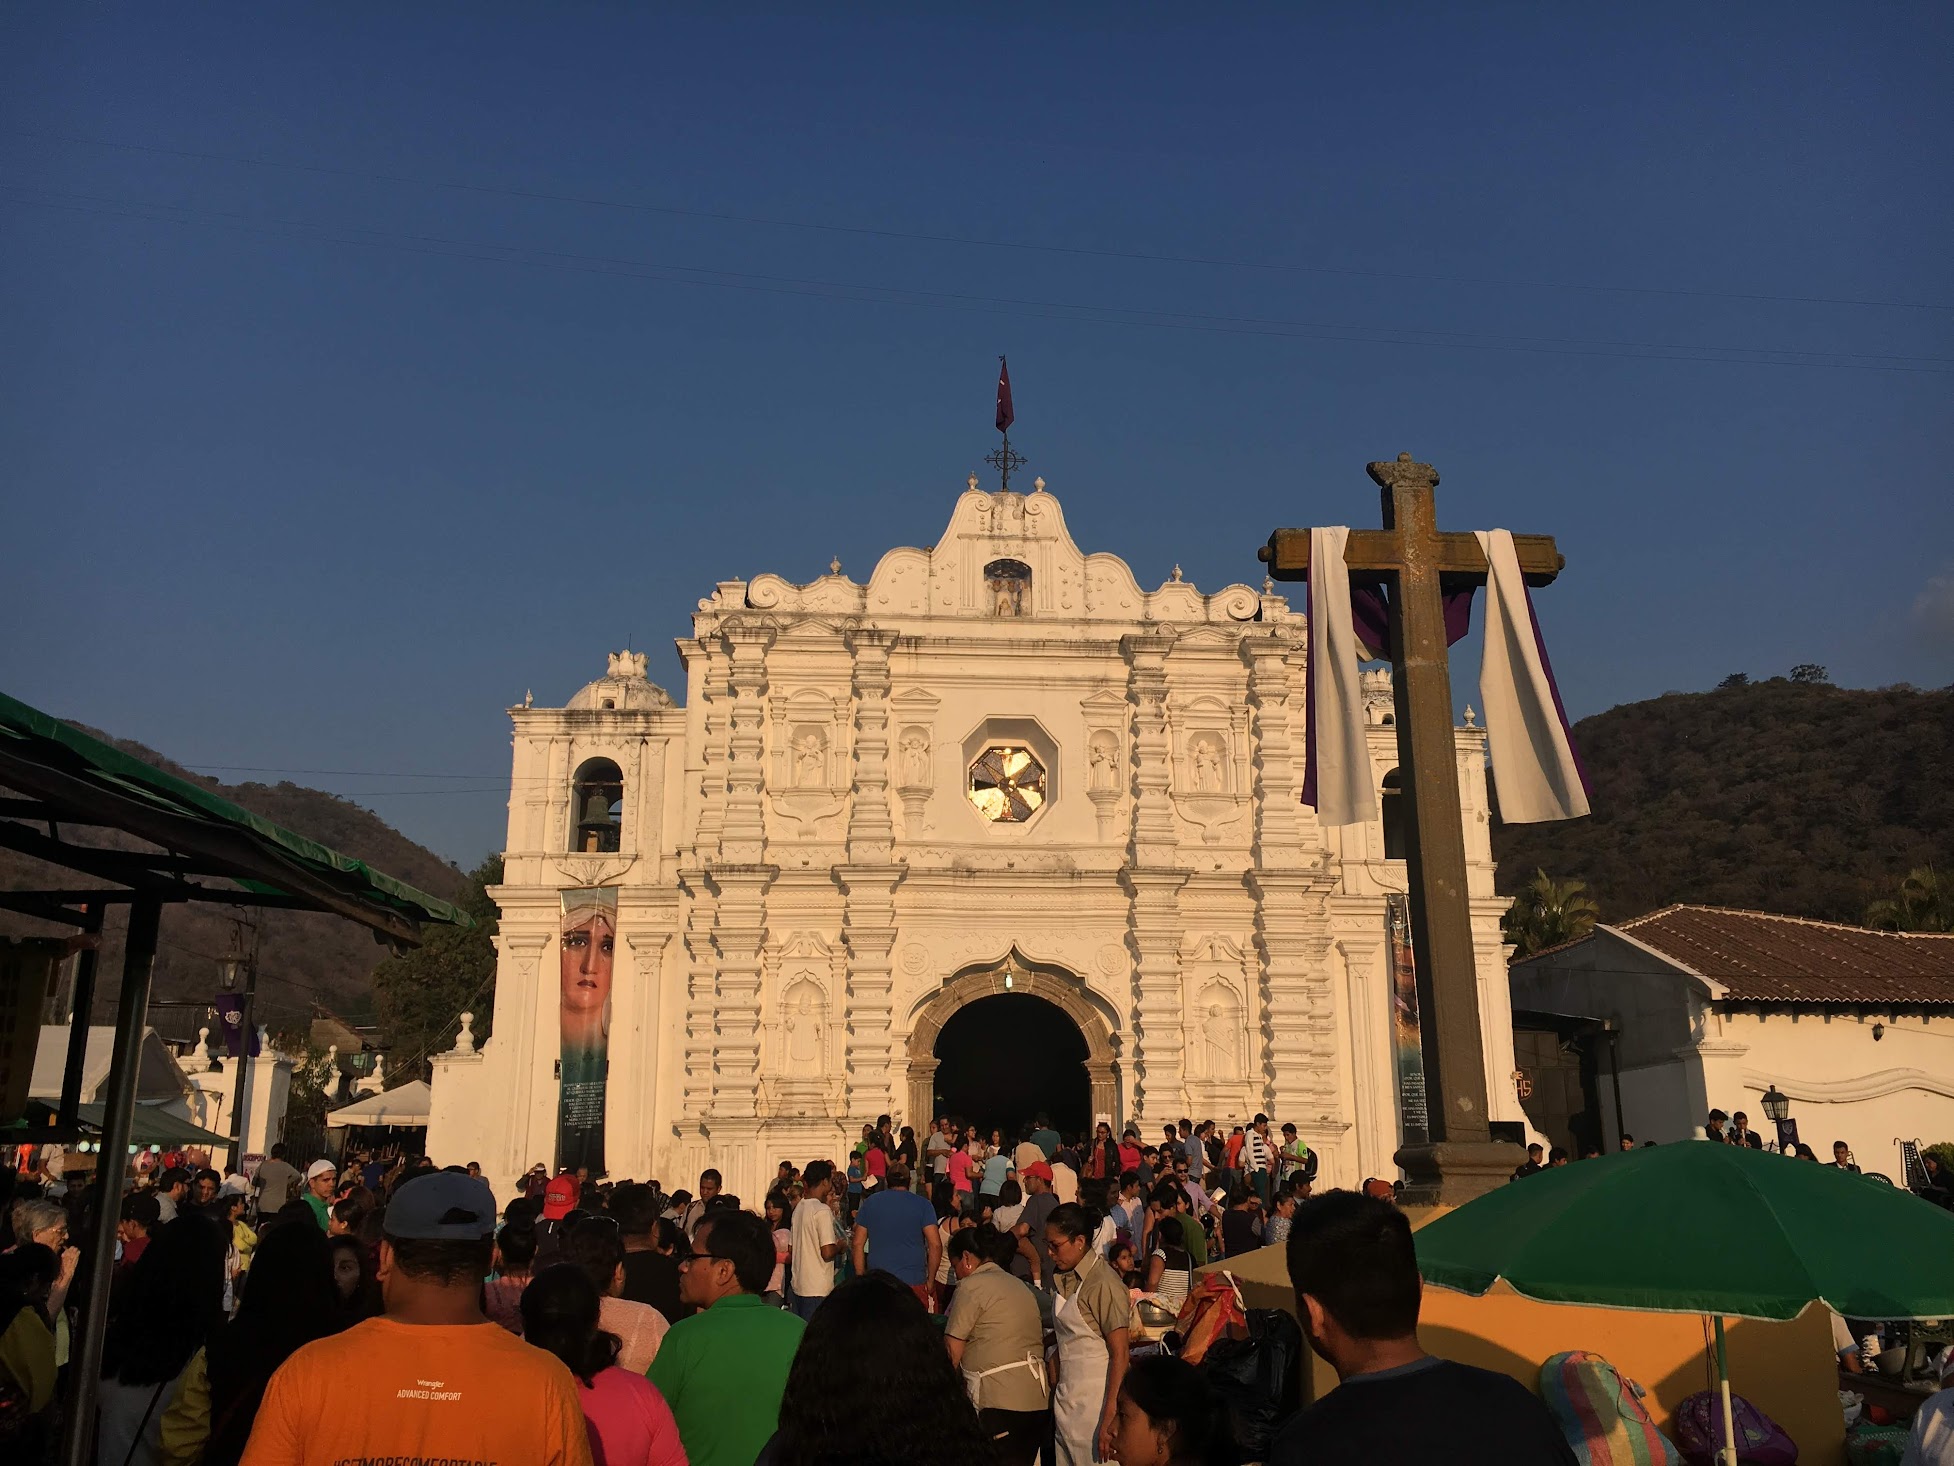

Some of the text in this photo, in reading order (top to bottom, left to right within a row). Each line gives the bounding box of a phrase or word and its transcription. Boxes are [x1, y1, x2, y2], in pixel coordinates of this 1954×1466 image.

[417, 1379, 445, 1390] Wrangler
[396, 1389, 462, 1401] ADVANCED COMFORT
